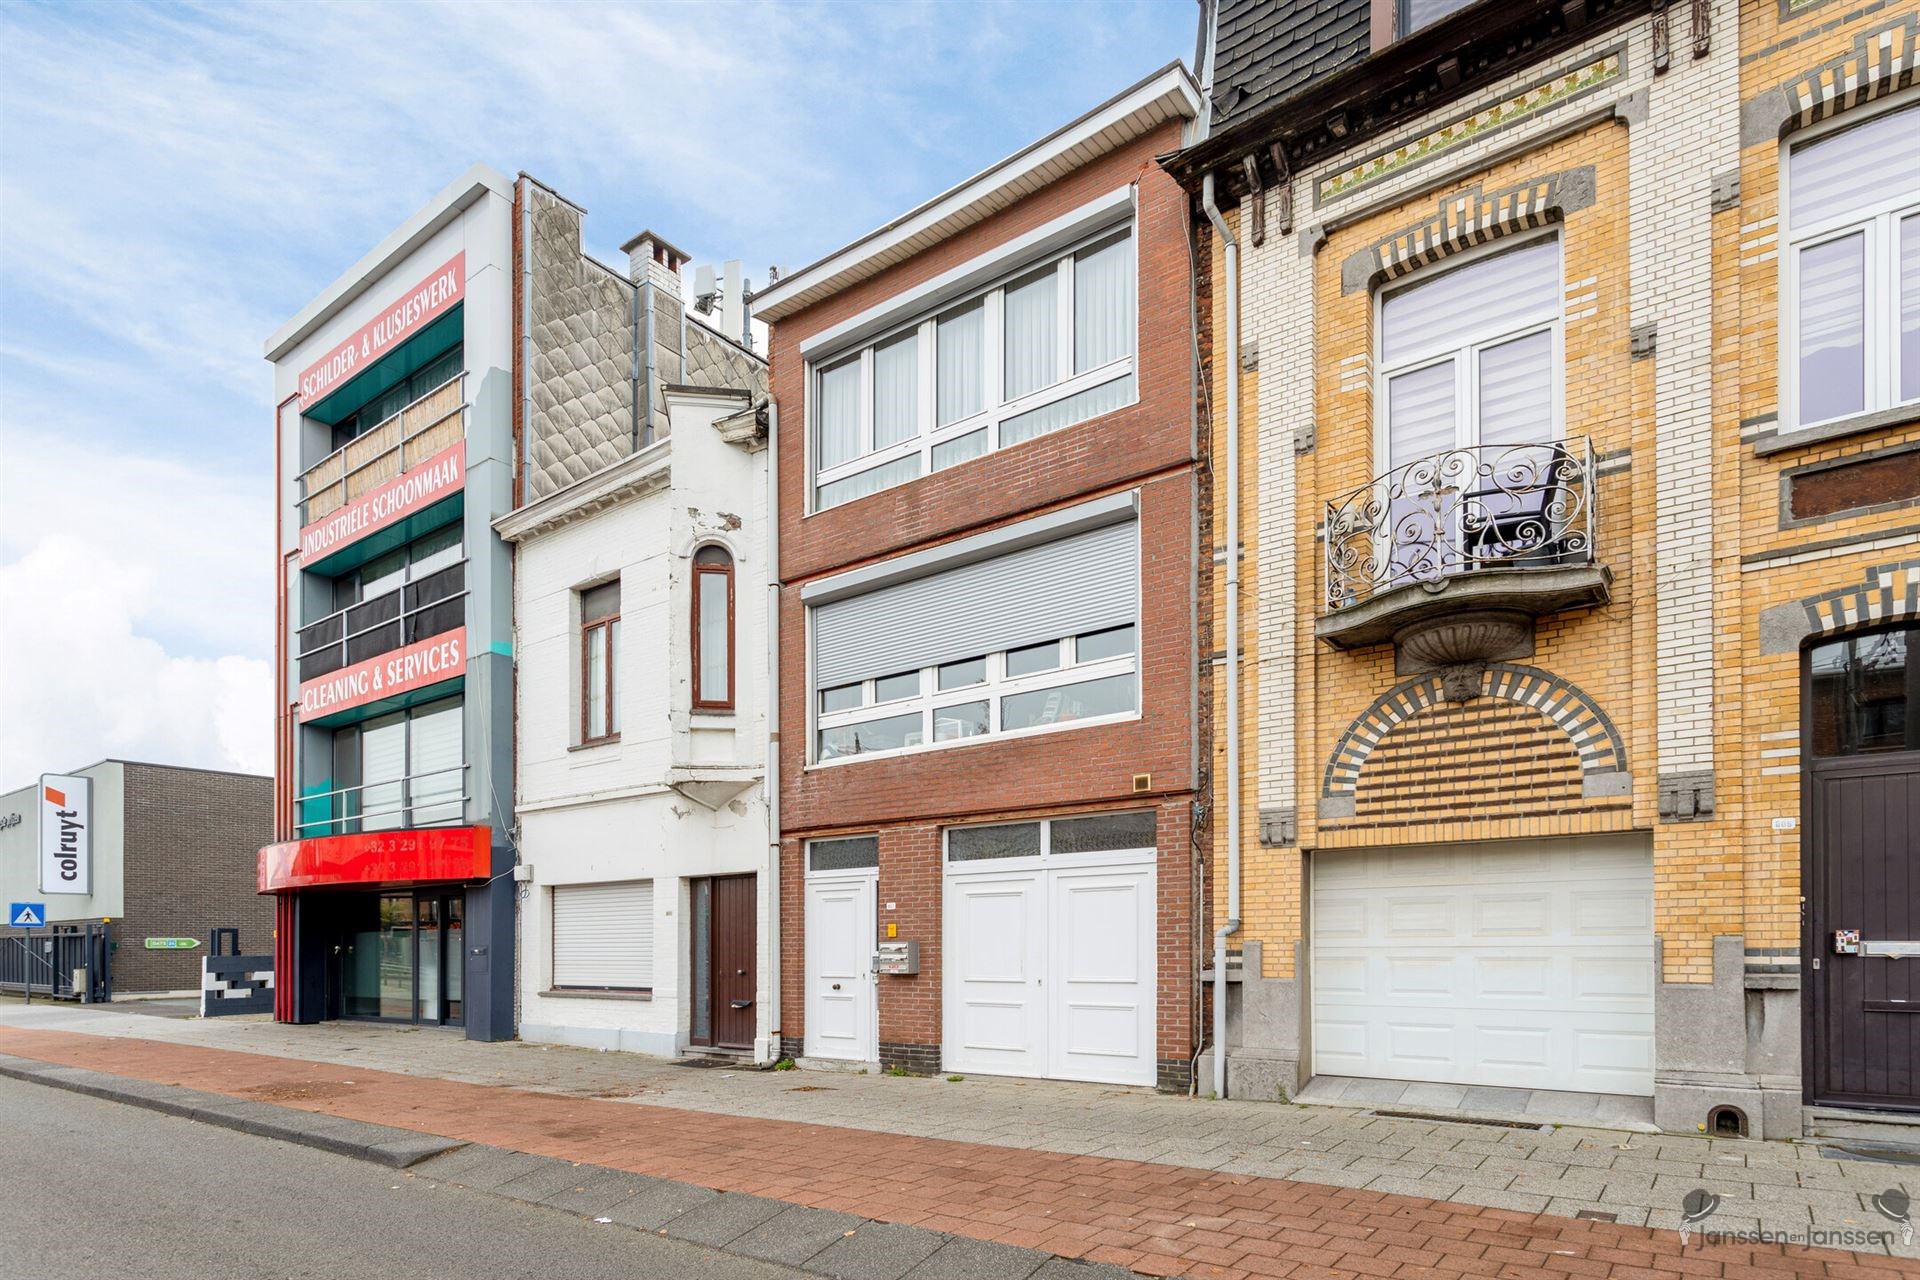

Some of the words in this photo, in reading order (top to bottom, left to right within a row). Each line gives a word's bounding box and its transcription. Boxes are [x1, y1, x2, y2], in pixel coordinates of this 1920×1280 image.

[361, 333, 370, 358] &
[373, 267, 457, 350] KLUSJESWERK
[372, 453, 458, 523] SCHOONMAAK
[304, 670, 368, 712] CLEANING
[373, 665, 383, 690] &
[387, 639, 459, 686] SERVICES
[53, 810, 84, 881] colruyt
[388, 839, 396, 852] 3
